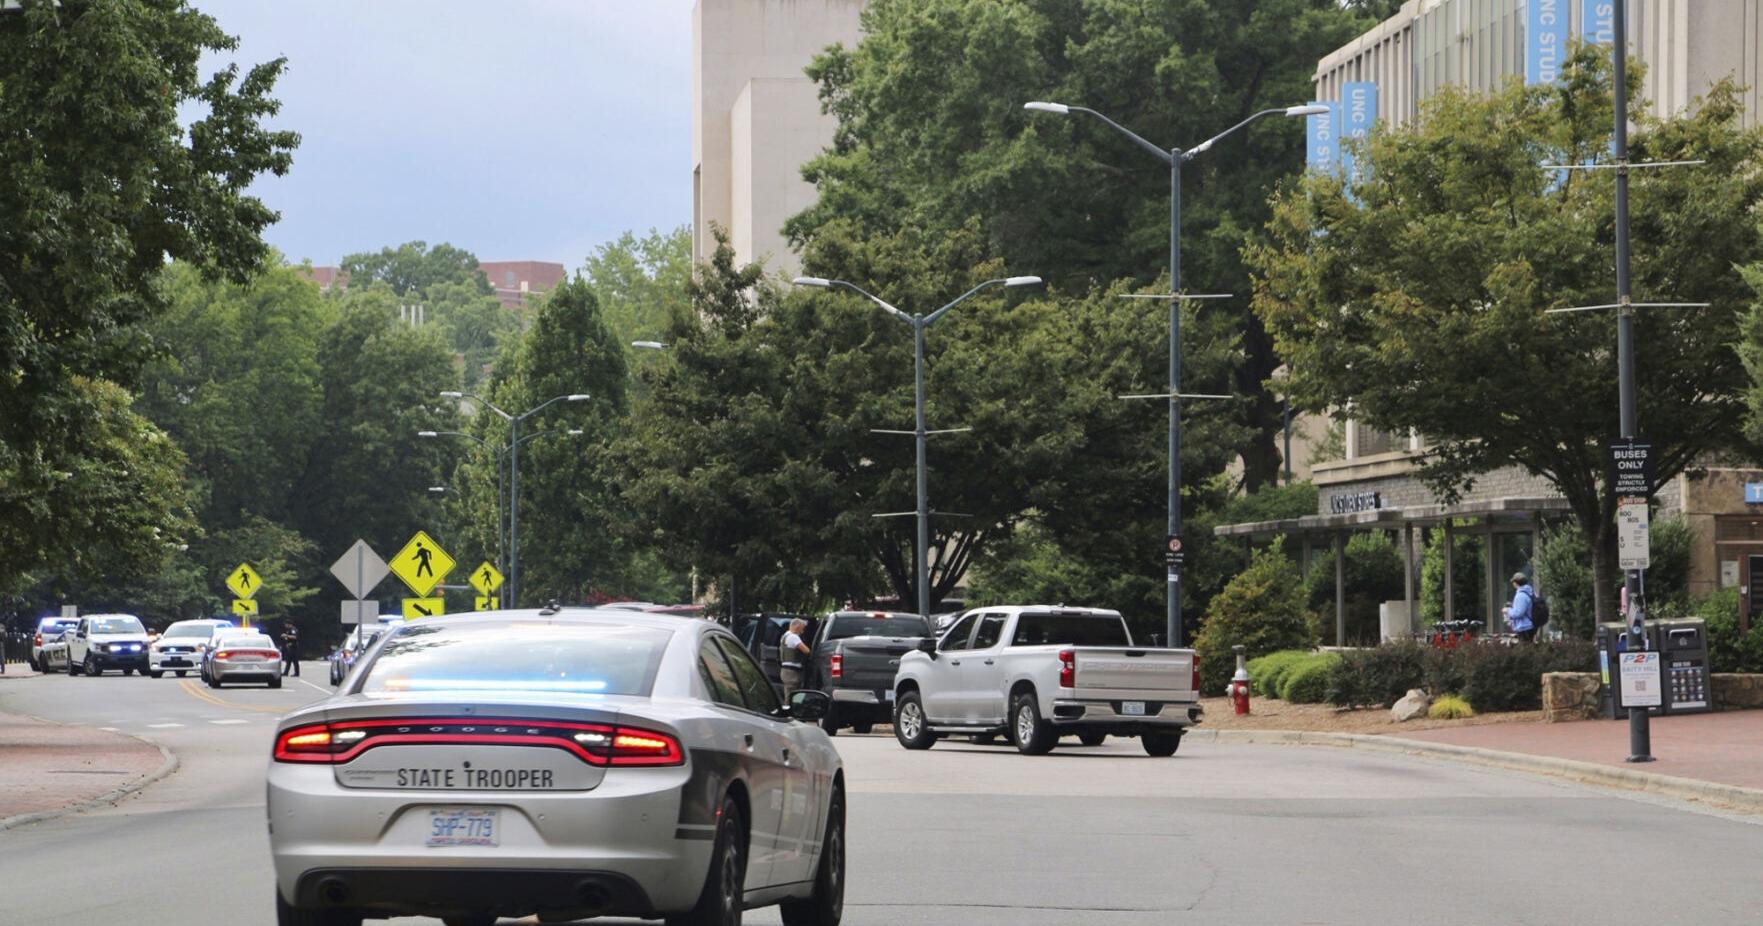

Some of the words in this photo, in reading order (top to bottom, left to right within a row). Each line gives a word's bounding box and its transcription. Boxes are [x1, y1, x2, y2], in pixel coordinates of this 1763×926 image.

[1352, 89, 1365, 122] UNC
[1614, 450, 1647, 459] BUSES
[1618, 460, 1644, 469] ONLY
[1624, 653, 1658, 664] P2P
[398, 726, 540, 735] DODGE
[397, 768, 455, 787] STATE
[464, 769, 554, 788] TROOPER
[432, 817, 492, 837] SHP-779
